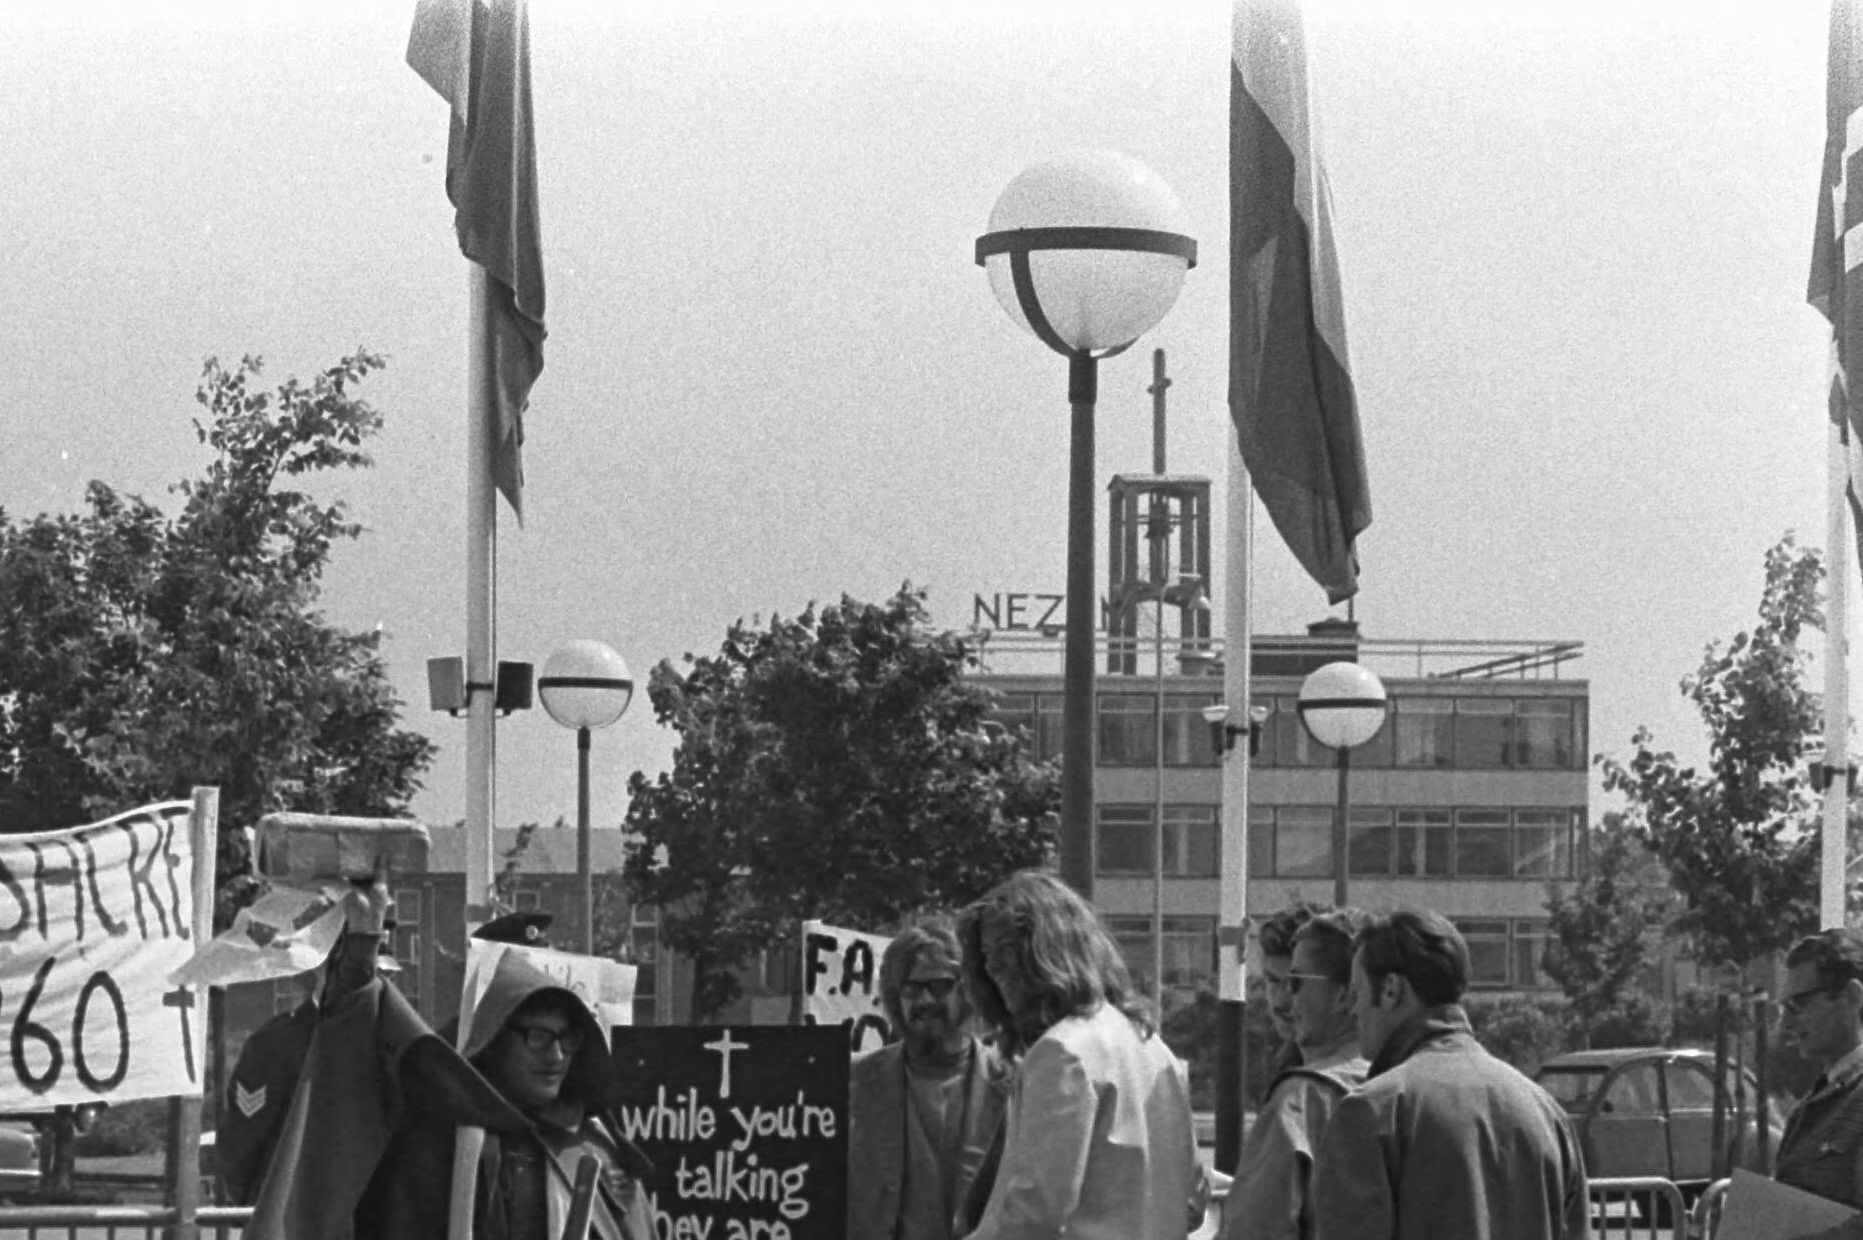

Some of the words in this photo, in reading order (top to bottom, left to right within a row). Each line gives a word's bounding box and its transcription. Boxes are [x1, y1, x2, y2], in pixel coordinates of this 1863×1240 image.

[622, 1084, 716, 1141] while
[730, 1090, 837, 1151] you're
[675, 1150, 810, 1219] talking
